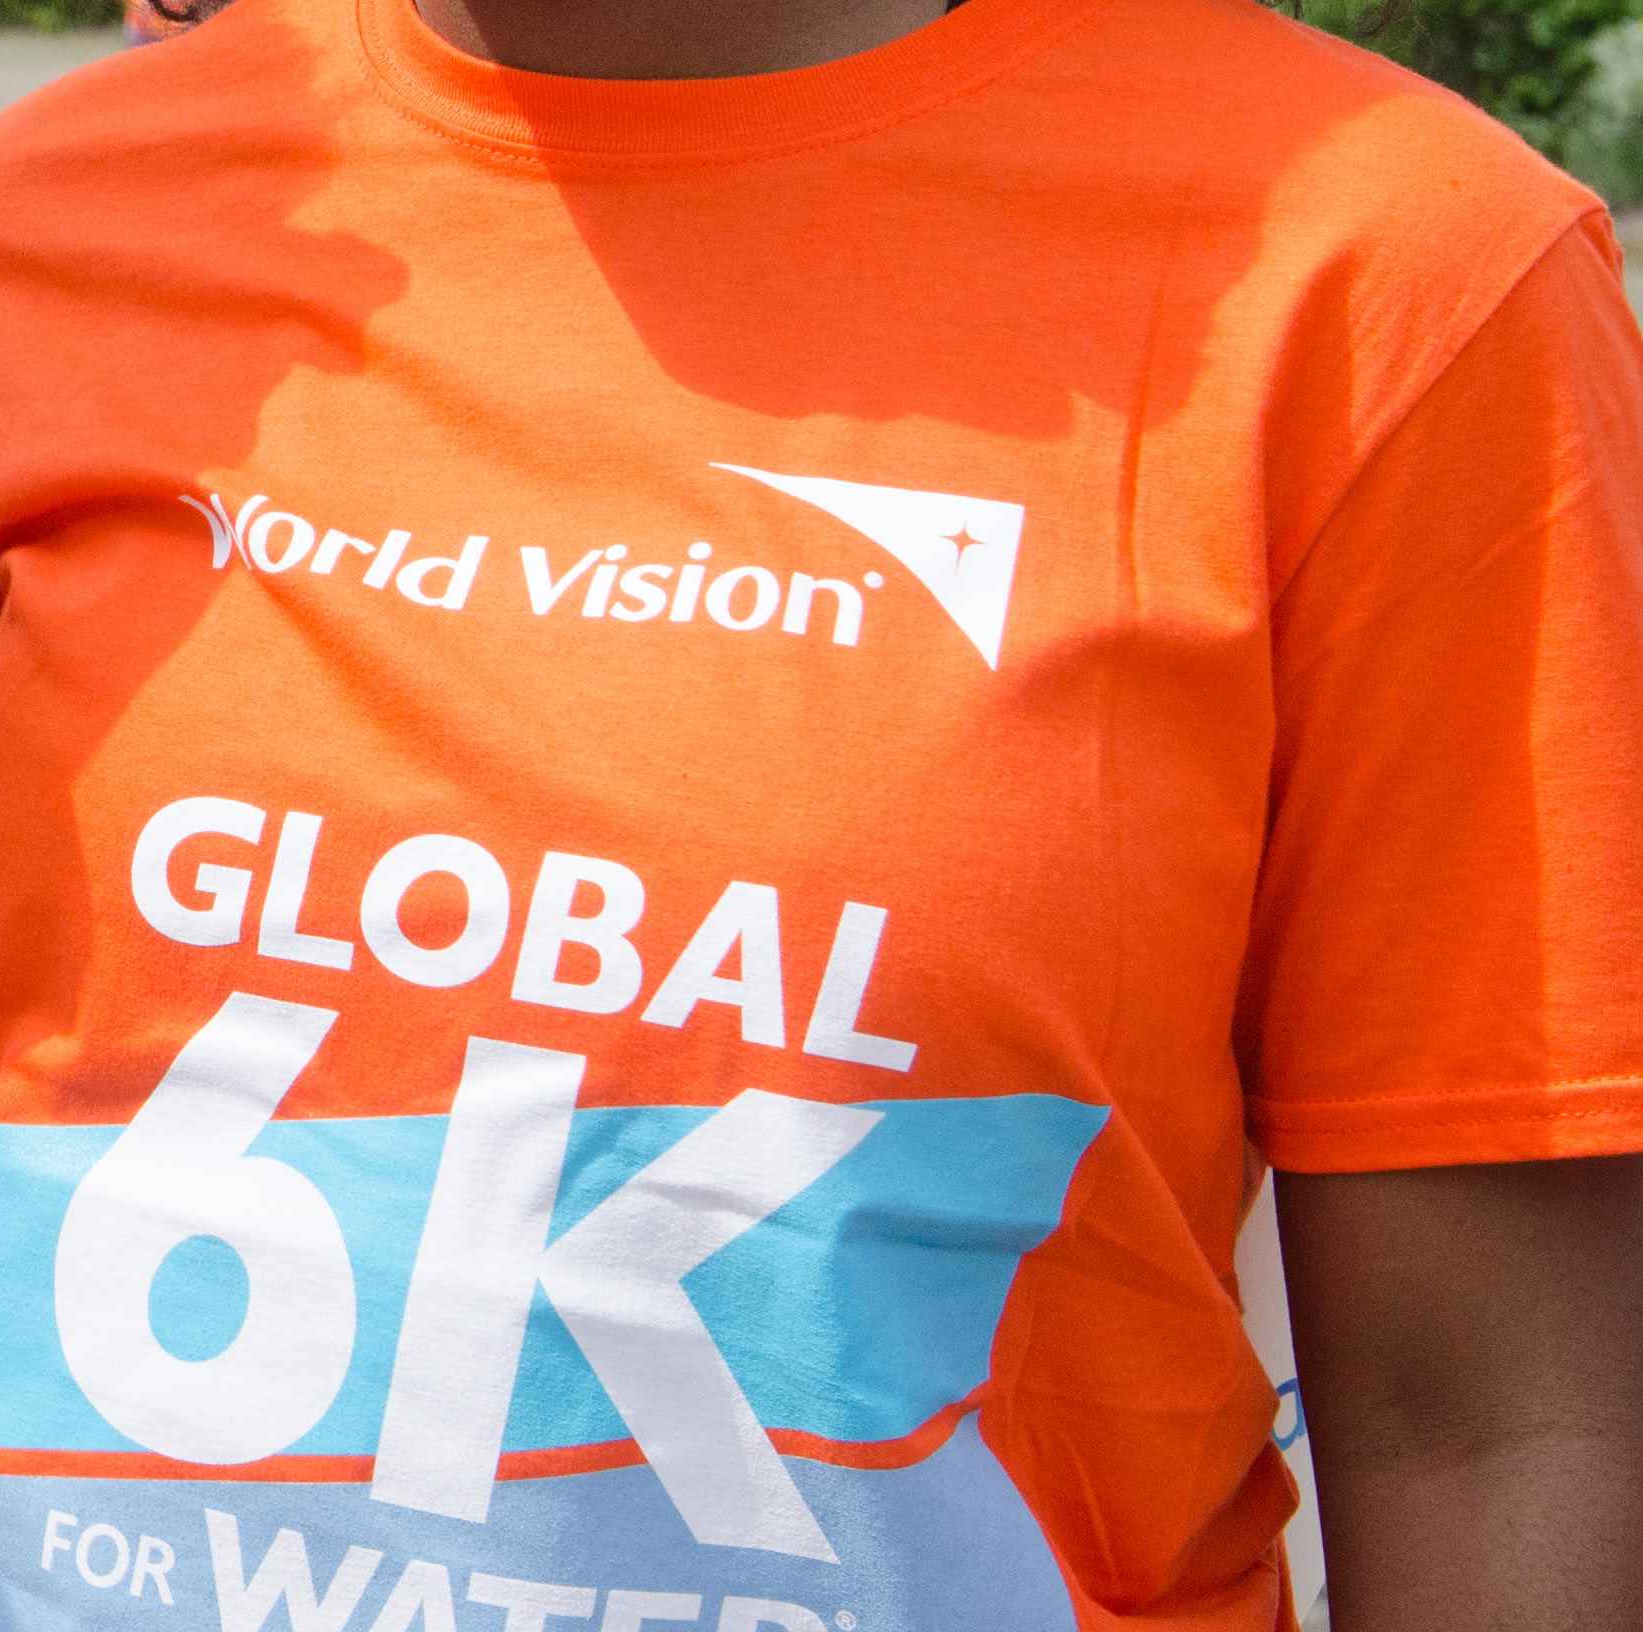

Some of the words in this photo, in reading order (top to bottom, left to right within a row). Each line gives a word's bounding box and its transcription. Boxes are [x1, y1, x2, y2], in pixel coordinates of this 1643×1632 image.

[129, 795, 918, 1074] GLOBAL
[54, 991, 885, 1566] 6K
[40, 1508, 177, 1606] FOR
